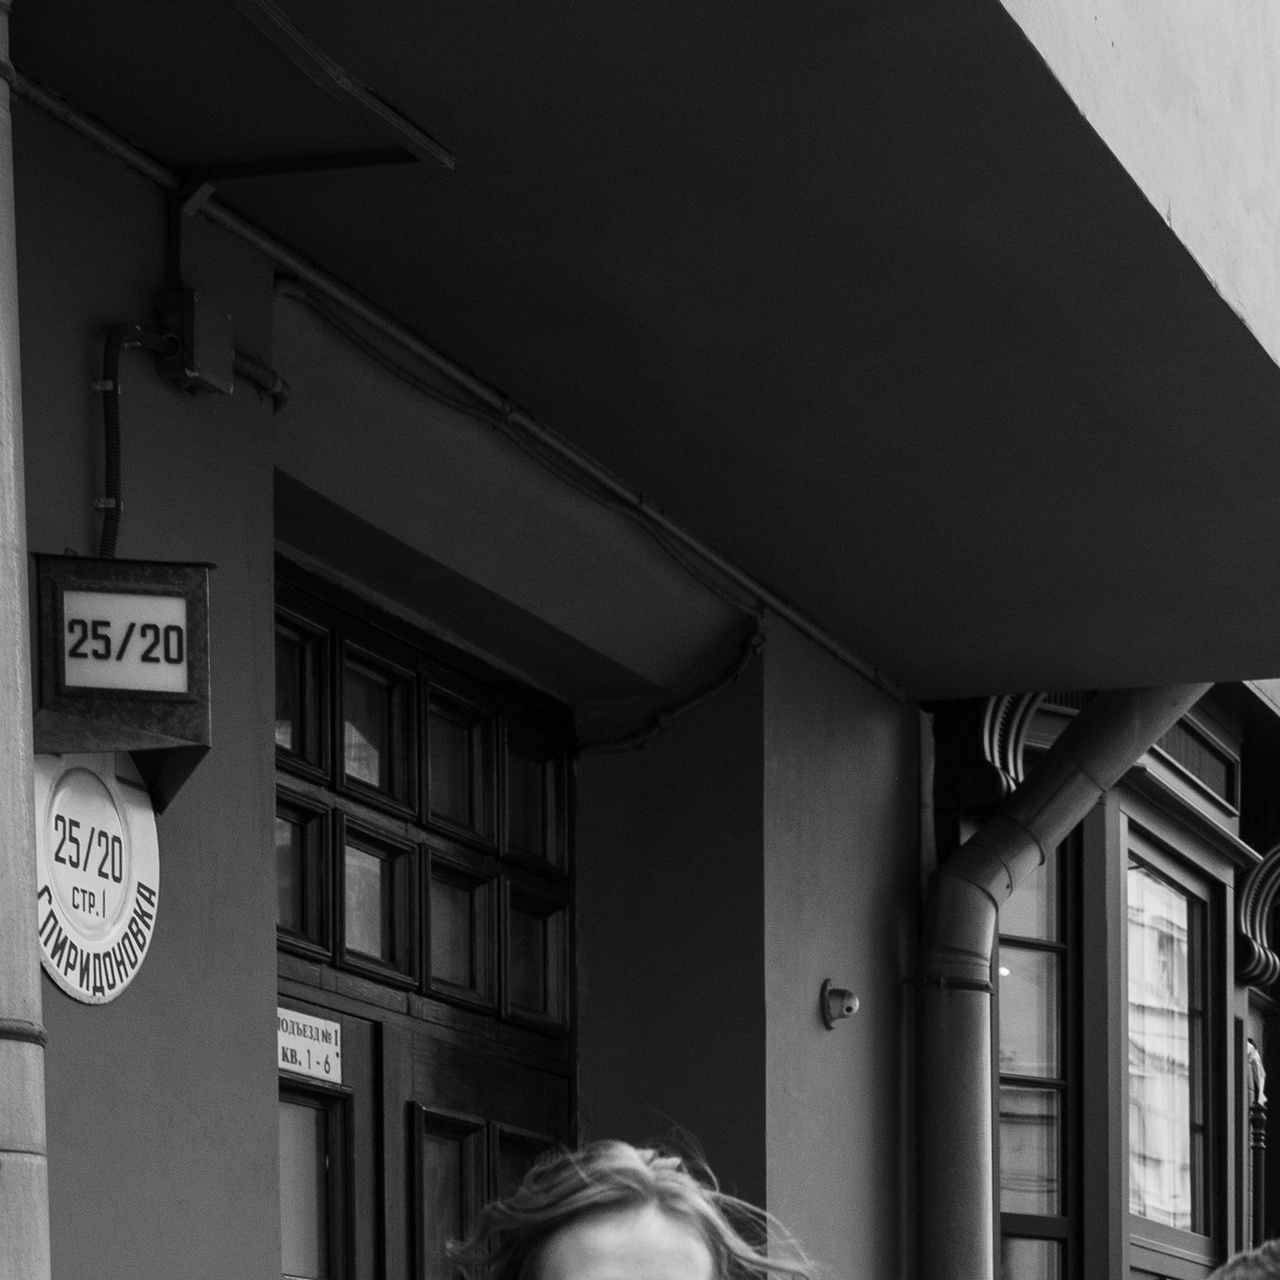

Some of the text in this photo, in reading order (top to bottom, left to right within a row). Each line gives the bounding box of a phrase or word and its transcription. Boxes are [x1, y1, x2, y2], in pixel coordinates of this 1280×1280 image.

[67, 618, 184, 664] 25/20
[54, 813, 123, 883] 25/20
[281, 1045, 302, 1066] КВ.
